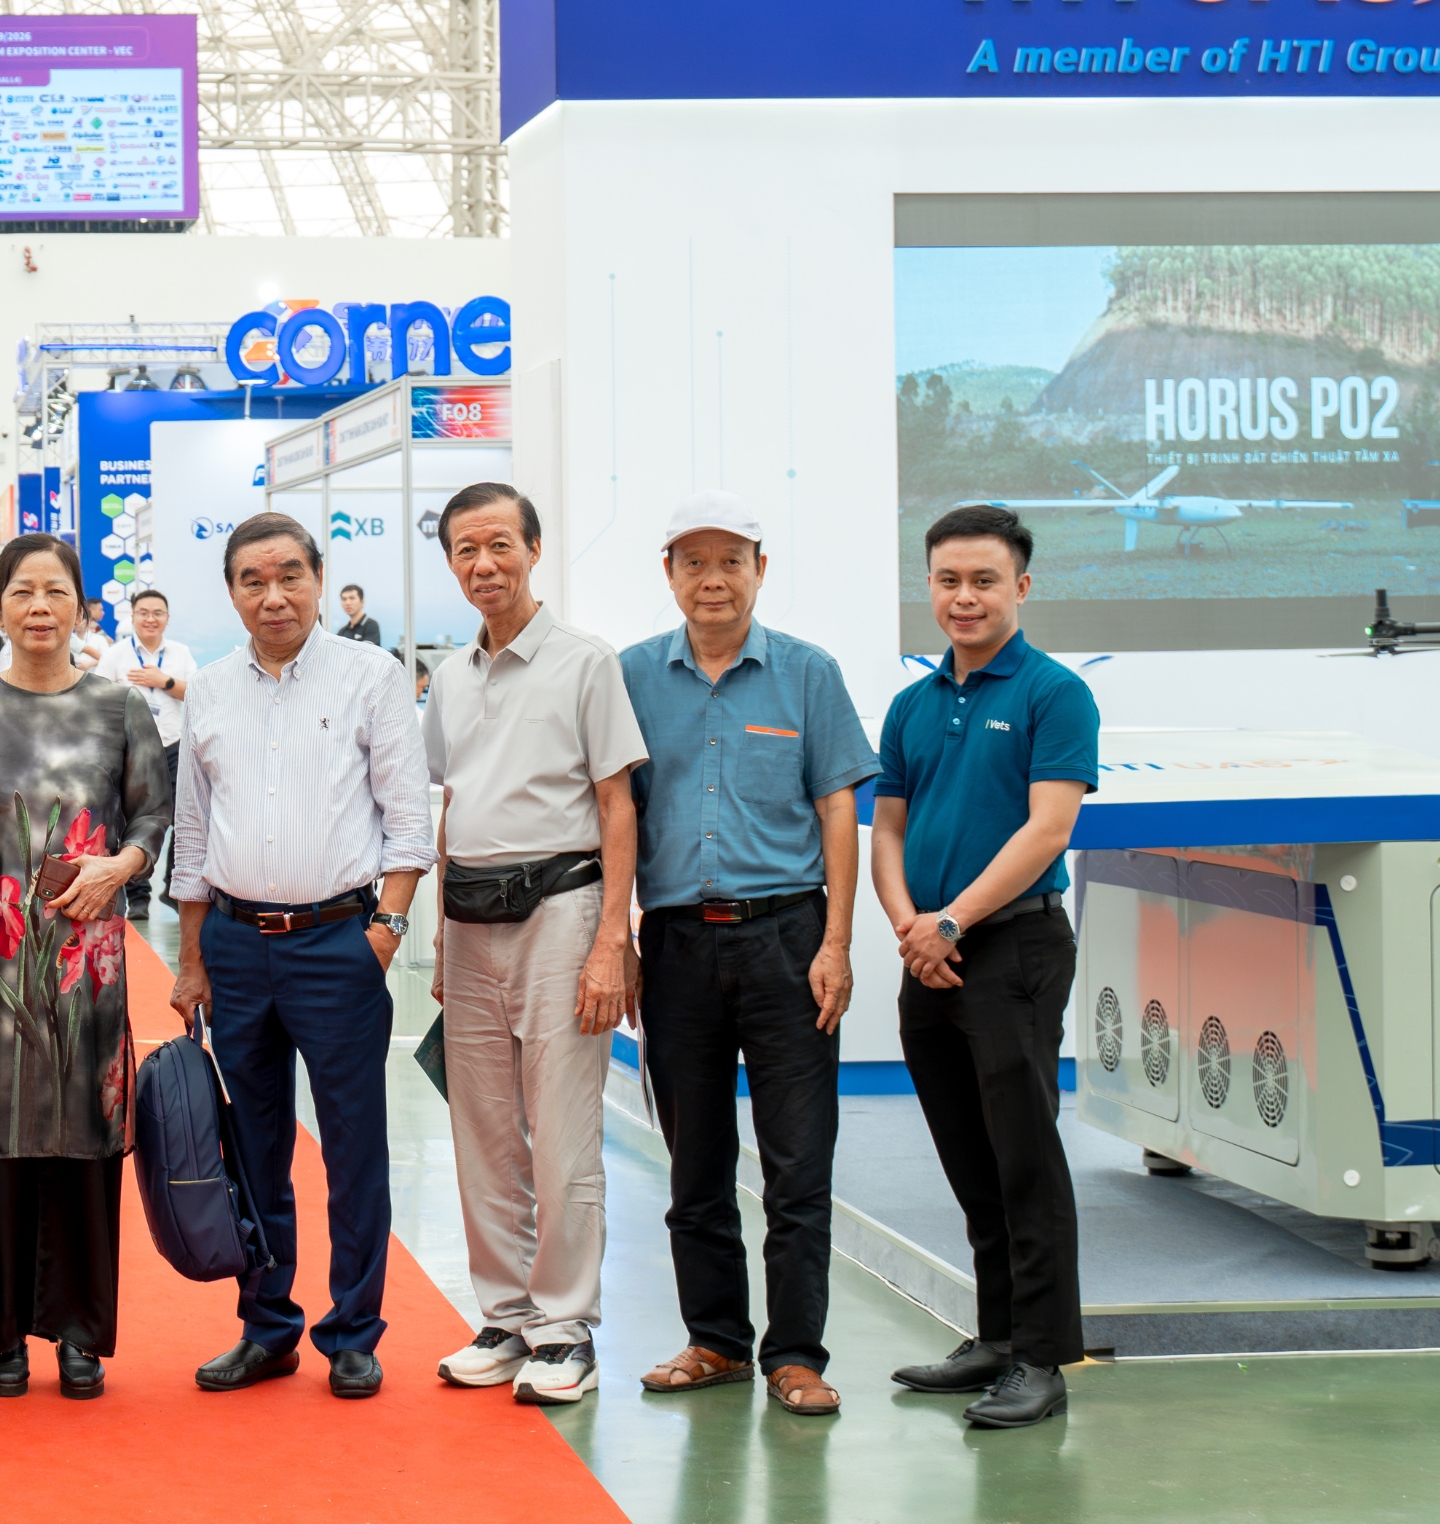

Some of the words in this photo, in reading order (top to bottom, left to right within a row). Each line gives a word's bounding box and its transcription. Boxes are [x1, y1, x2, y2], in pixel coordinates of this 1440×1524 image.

[7, 47, 66, 56] EXPOSITION
[68, 46, 107, 56] CENTER
[114, 46, 133, 55] VEC
[966, 38, 999, 73] A
[1013, 37, 1190, 73] member
[1201, 36, 1251, 73] of
[1257, 39, 1334, 73] HTI
[1346, 38, 1440, 74] Grou
[1145, 376, 1299, 441] HORUS
[100, 474, 152, 485] PARTNE
[355, 518, 385, 536] XB
